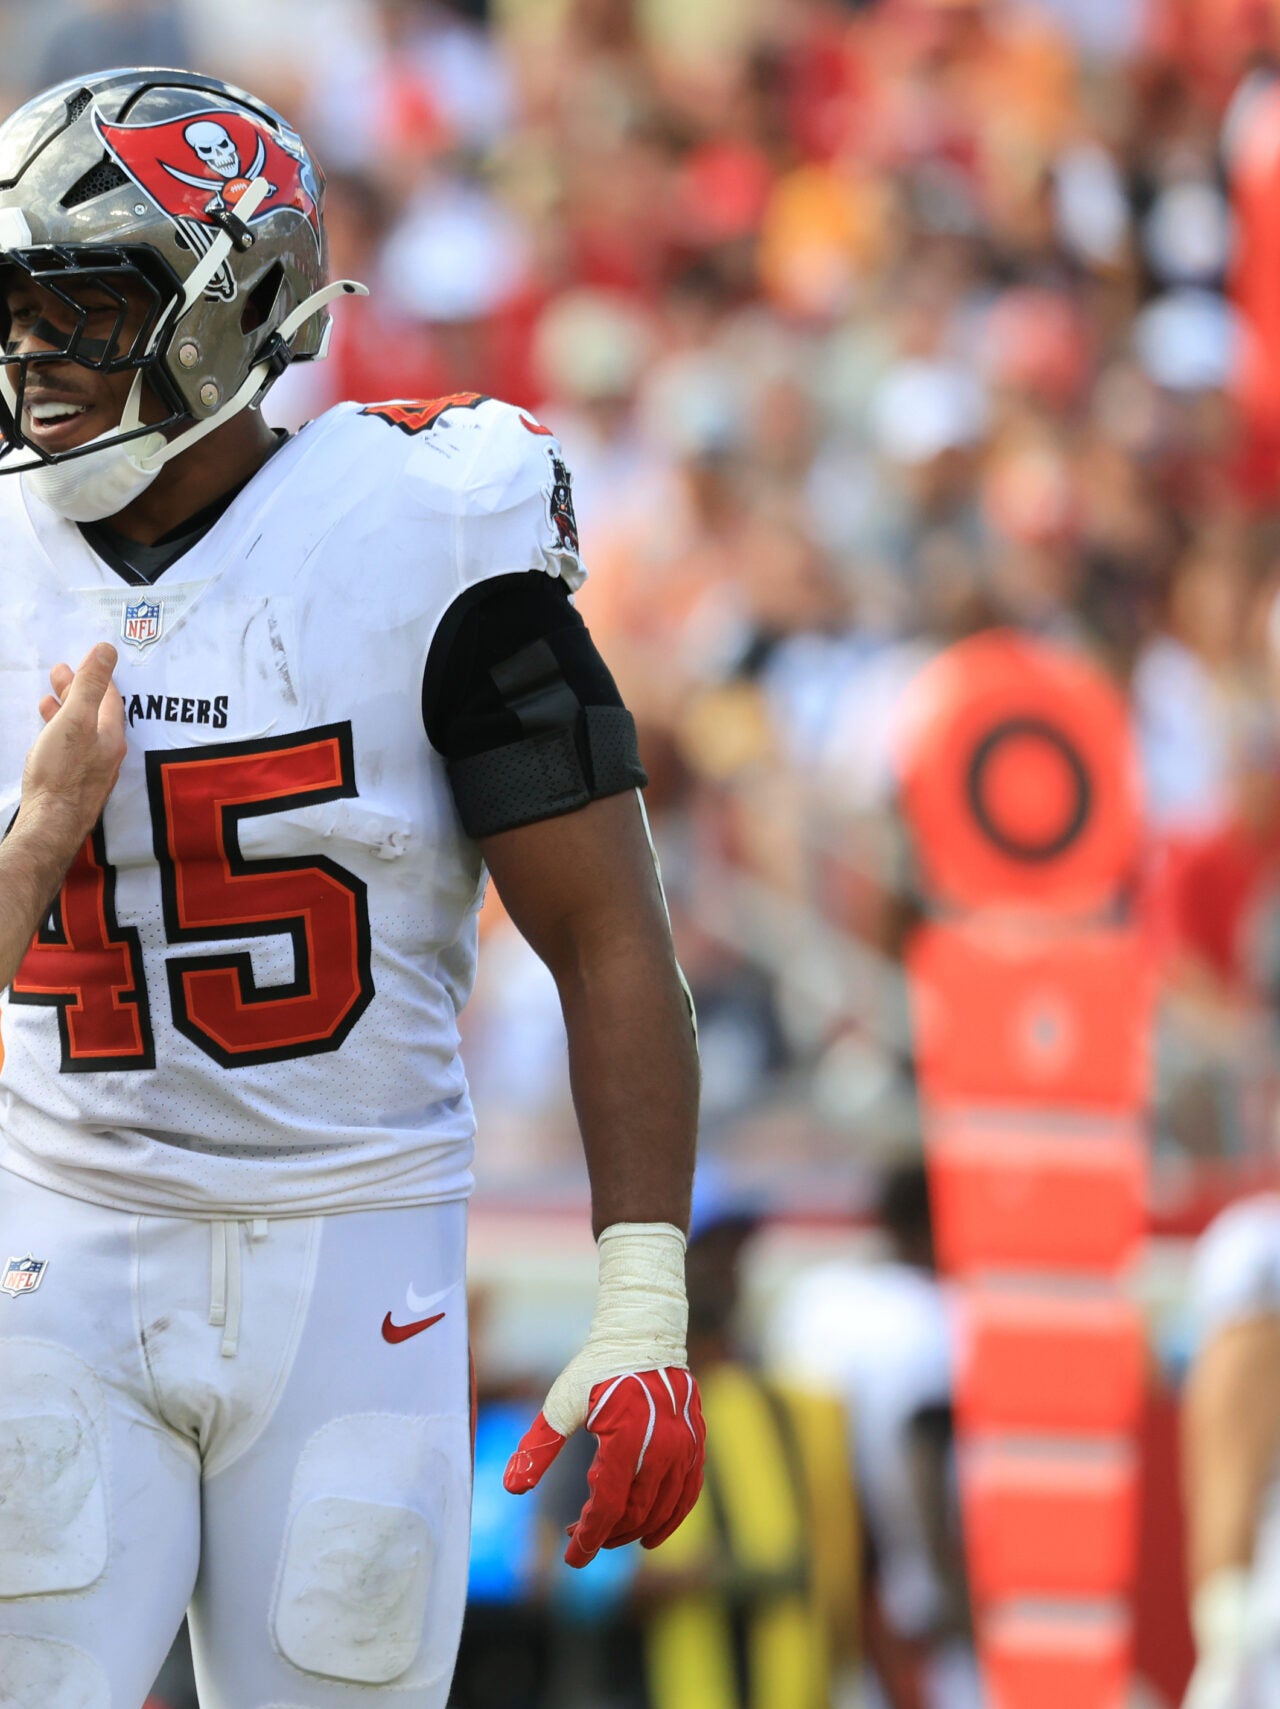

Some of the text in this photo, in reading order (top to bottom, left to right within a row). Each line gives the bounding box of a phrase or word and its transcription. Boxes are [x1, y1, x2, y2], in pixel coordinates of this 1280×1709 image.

[127, 619, 155, 640] NFL
[122, 694, 228, 728] ANEERS
[8, 720, 376, 1073] 45
[6, 1272, 33, 1289] NFL
